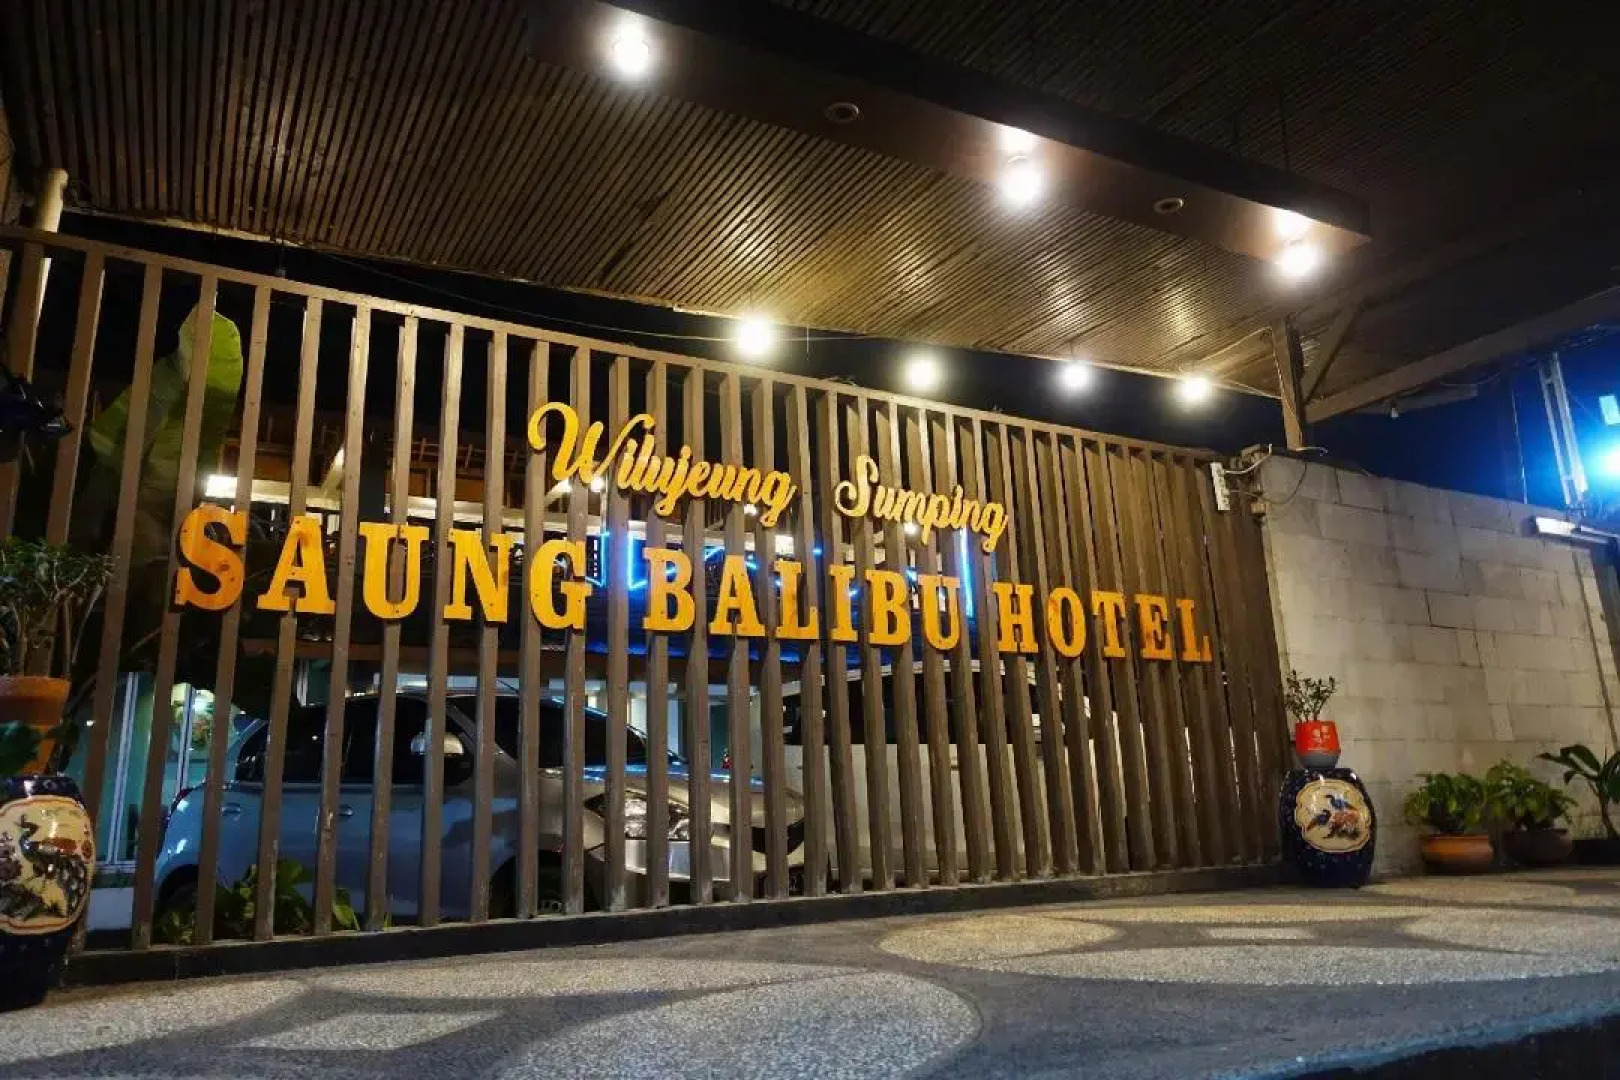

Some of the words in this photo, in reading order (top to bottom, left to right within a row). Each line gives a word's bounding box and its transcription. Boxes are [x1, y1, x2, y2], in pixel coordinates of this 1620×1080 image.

[527, 401, 797, 528] Wilujeung
[834, 455, 1008, 553] Sumping
[174, 504, 592, 631] SAUNG
[642, 547, 962, 651] BALIBU
[993, 581, 1212, 663] HOTEL
